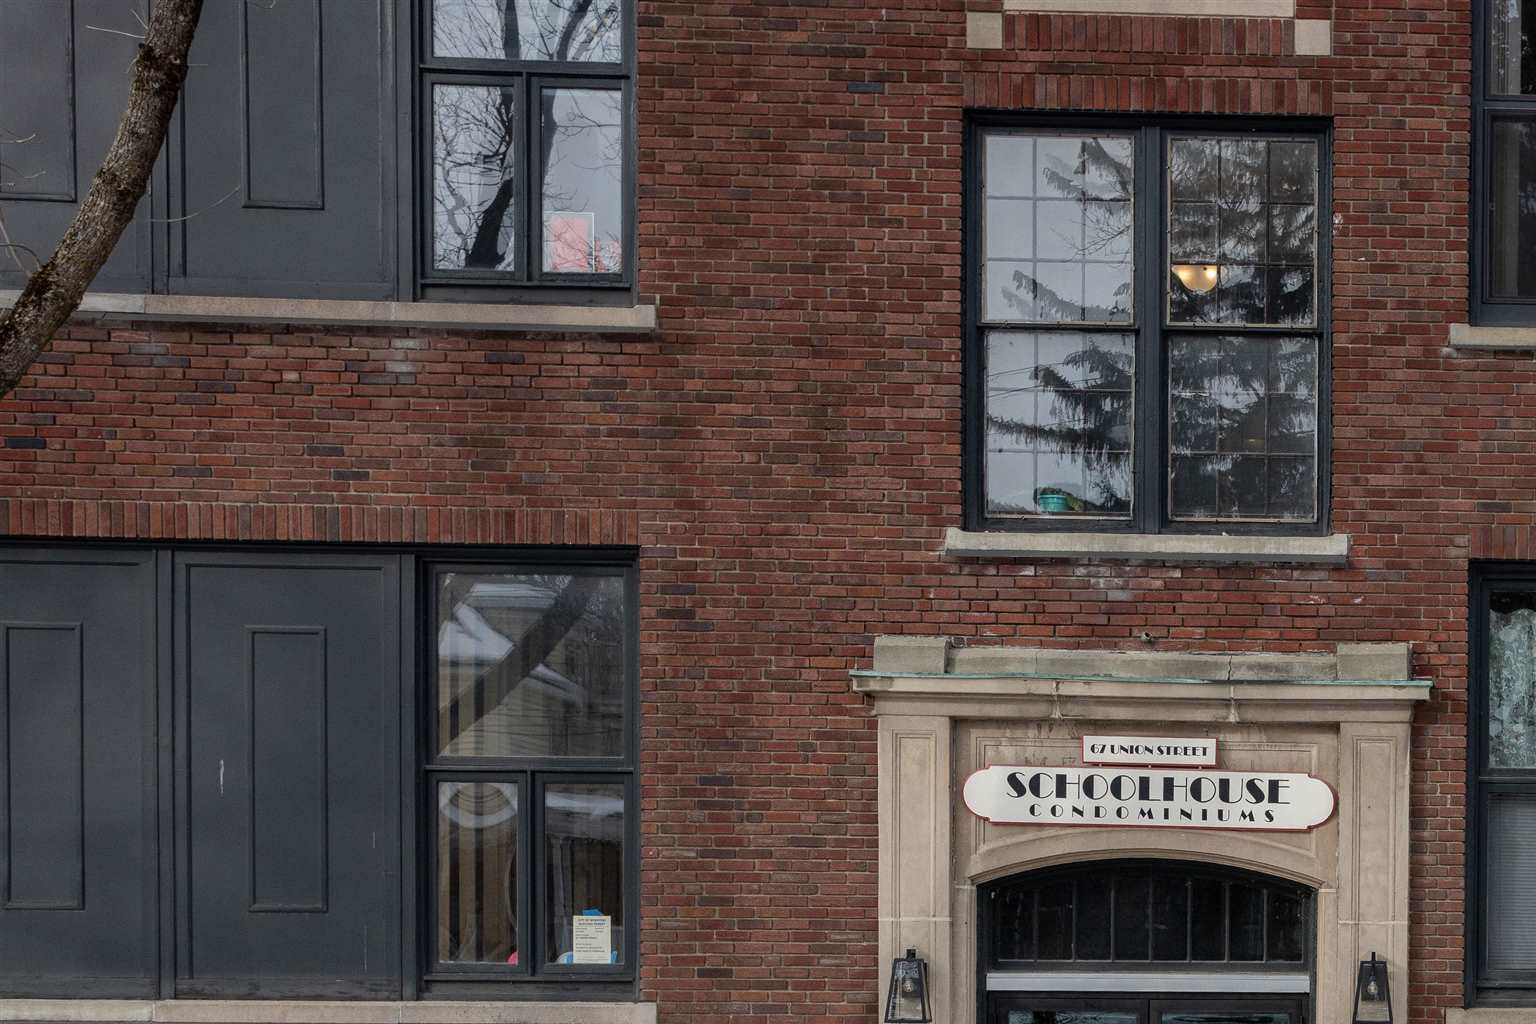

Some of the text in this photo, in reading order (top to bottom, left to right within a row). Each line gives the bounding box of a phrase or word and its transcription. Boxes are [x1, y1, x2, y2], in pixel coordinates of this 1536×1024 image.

[1090, 743, 1209, 757] 67 UNION STREET
[1006, 771, 1290, 804] SCHOOLHOUSE
[1029, 803, 1274, 822] CONDOMINIUMS
